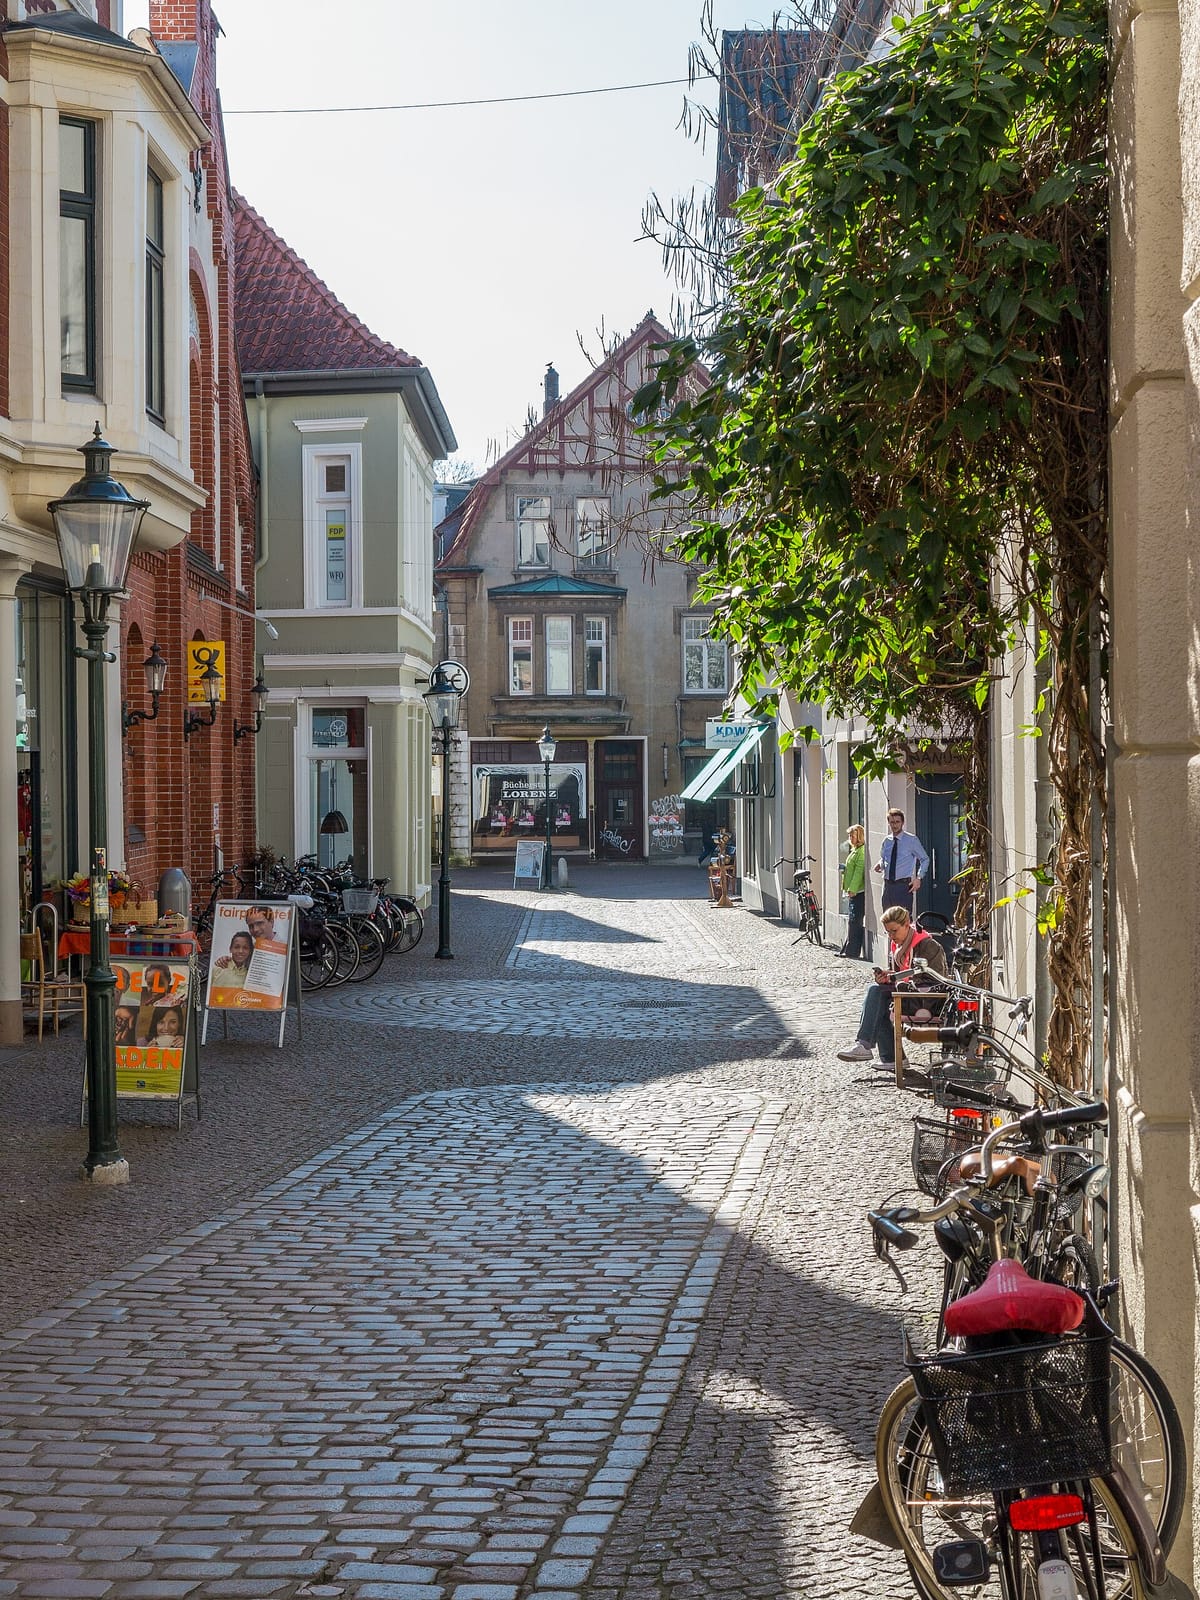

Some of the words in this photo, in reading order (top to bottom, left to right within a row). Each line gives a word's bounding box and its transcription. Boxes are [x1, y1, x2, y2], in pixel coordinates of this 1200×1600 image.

[329, 571, 344, 580] WFO
[716, 726, 746, 737] KDW
[503, 790, 557, 798] LORENZ
